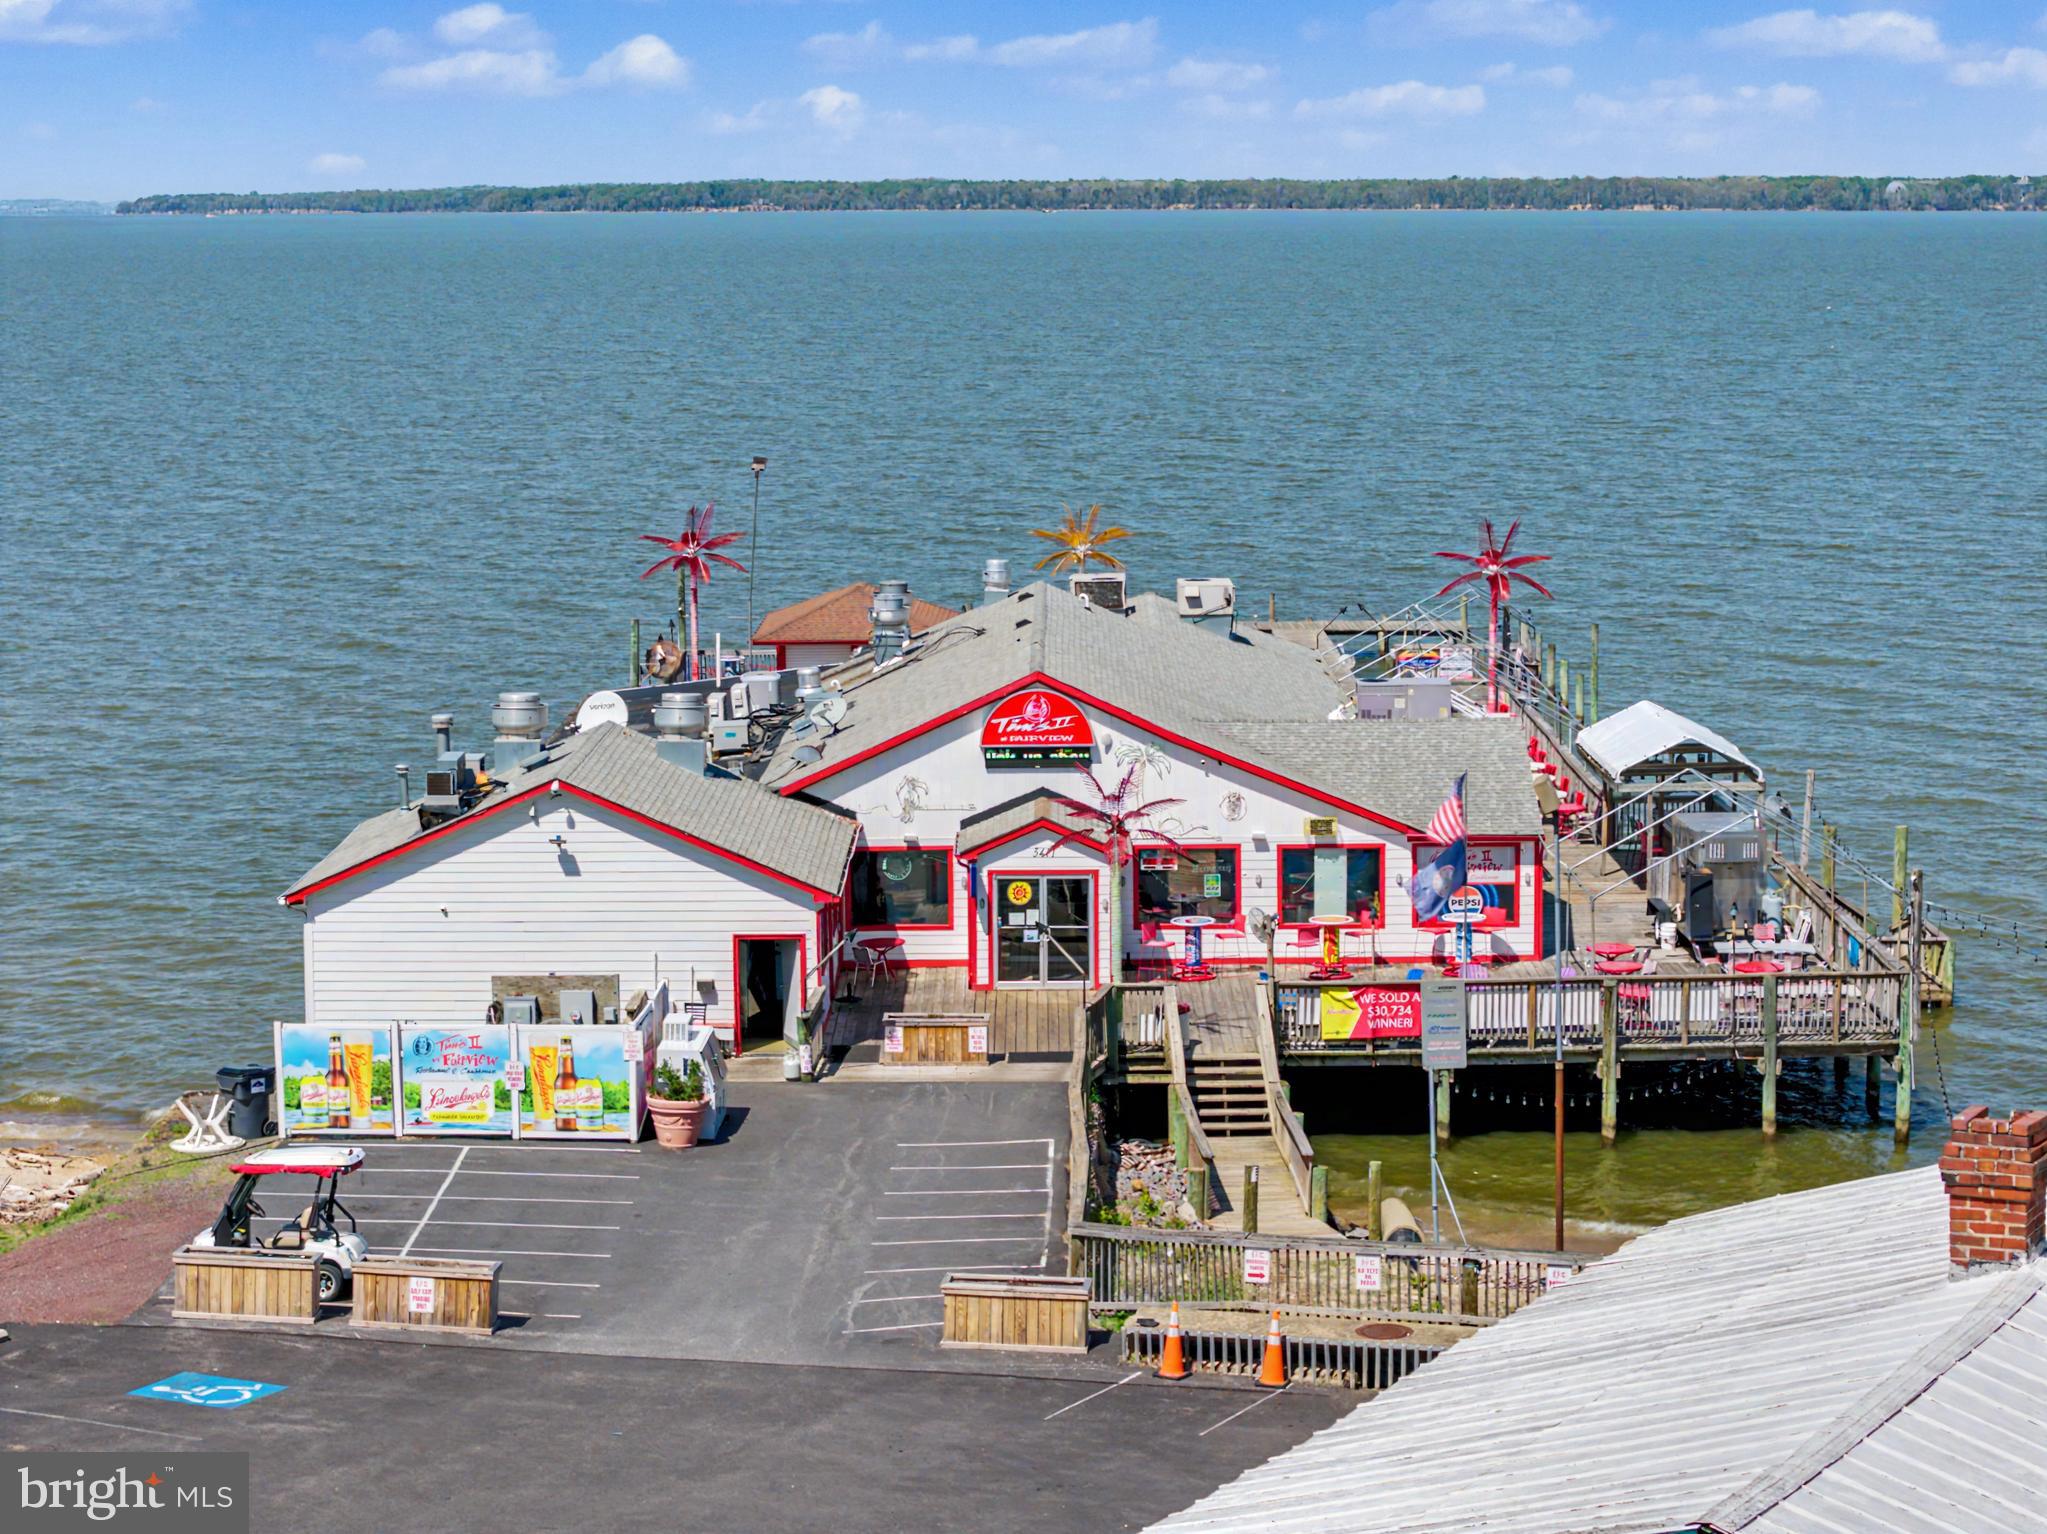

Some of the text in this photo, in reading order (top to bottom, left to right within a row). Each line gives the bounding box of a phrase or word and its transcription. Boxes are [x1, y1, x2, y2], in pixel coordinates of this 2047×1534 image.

[1052, 714, 1079, 728] II
[1009, 734, 1074, 743] FAIRVIEW
[1451, 898, 1481, 906] PEPSI
[1360, 992, 1421, 1004] WE SOLD A
[1367, 1005, 1413, 1018] $30,734
[1367, 1017, 1413, 1030] WINNER!
[468, 1035, 483, 1050] II
[442, 1052, 499, 1067] Fairview
